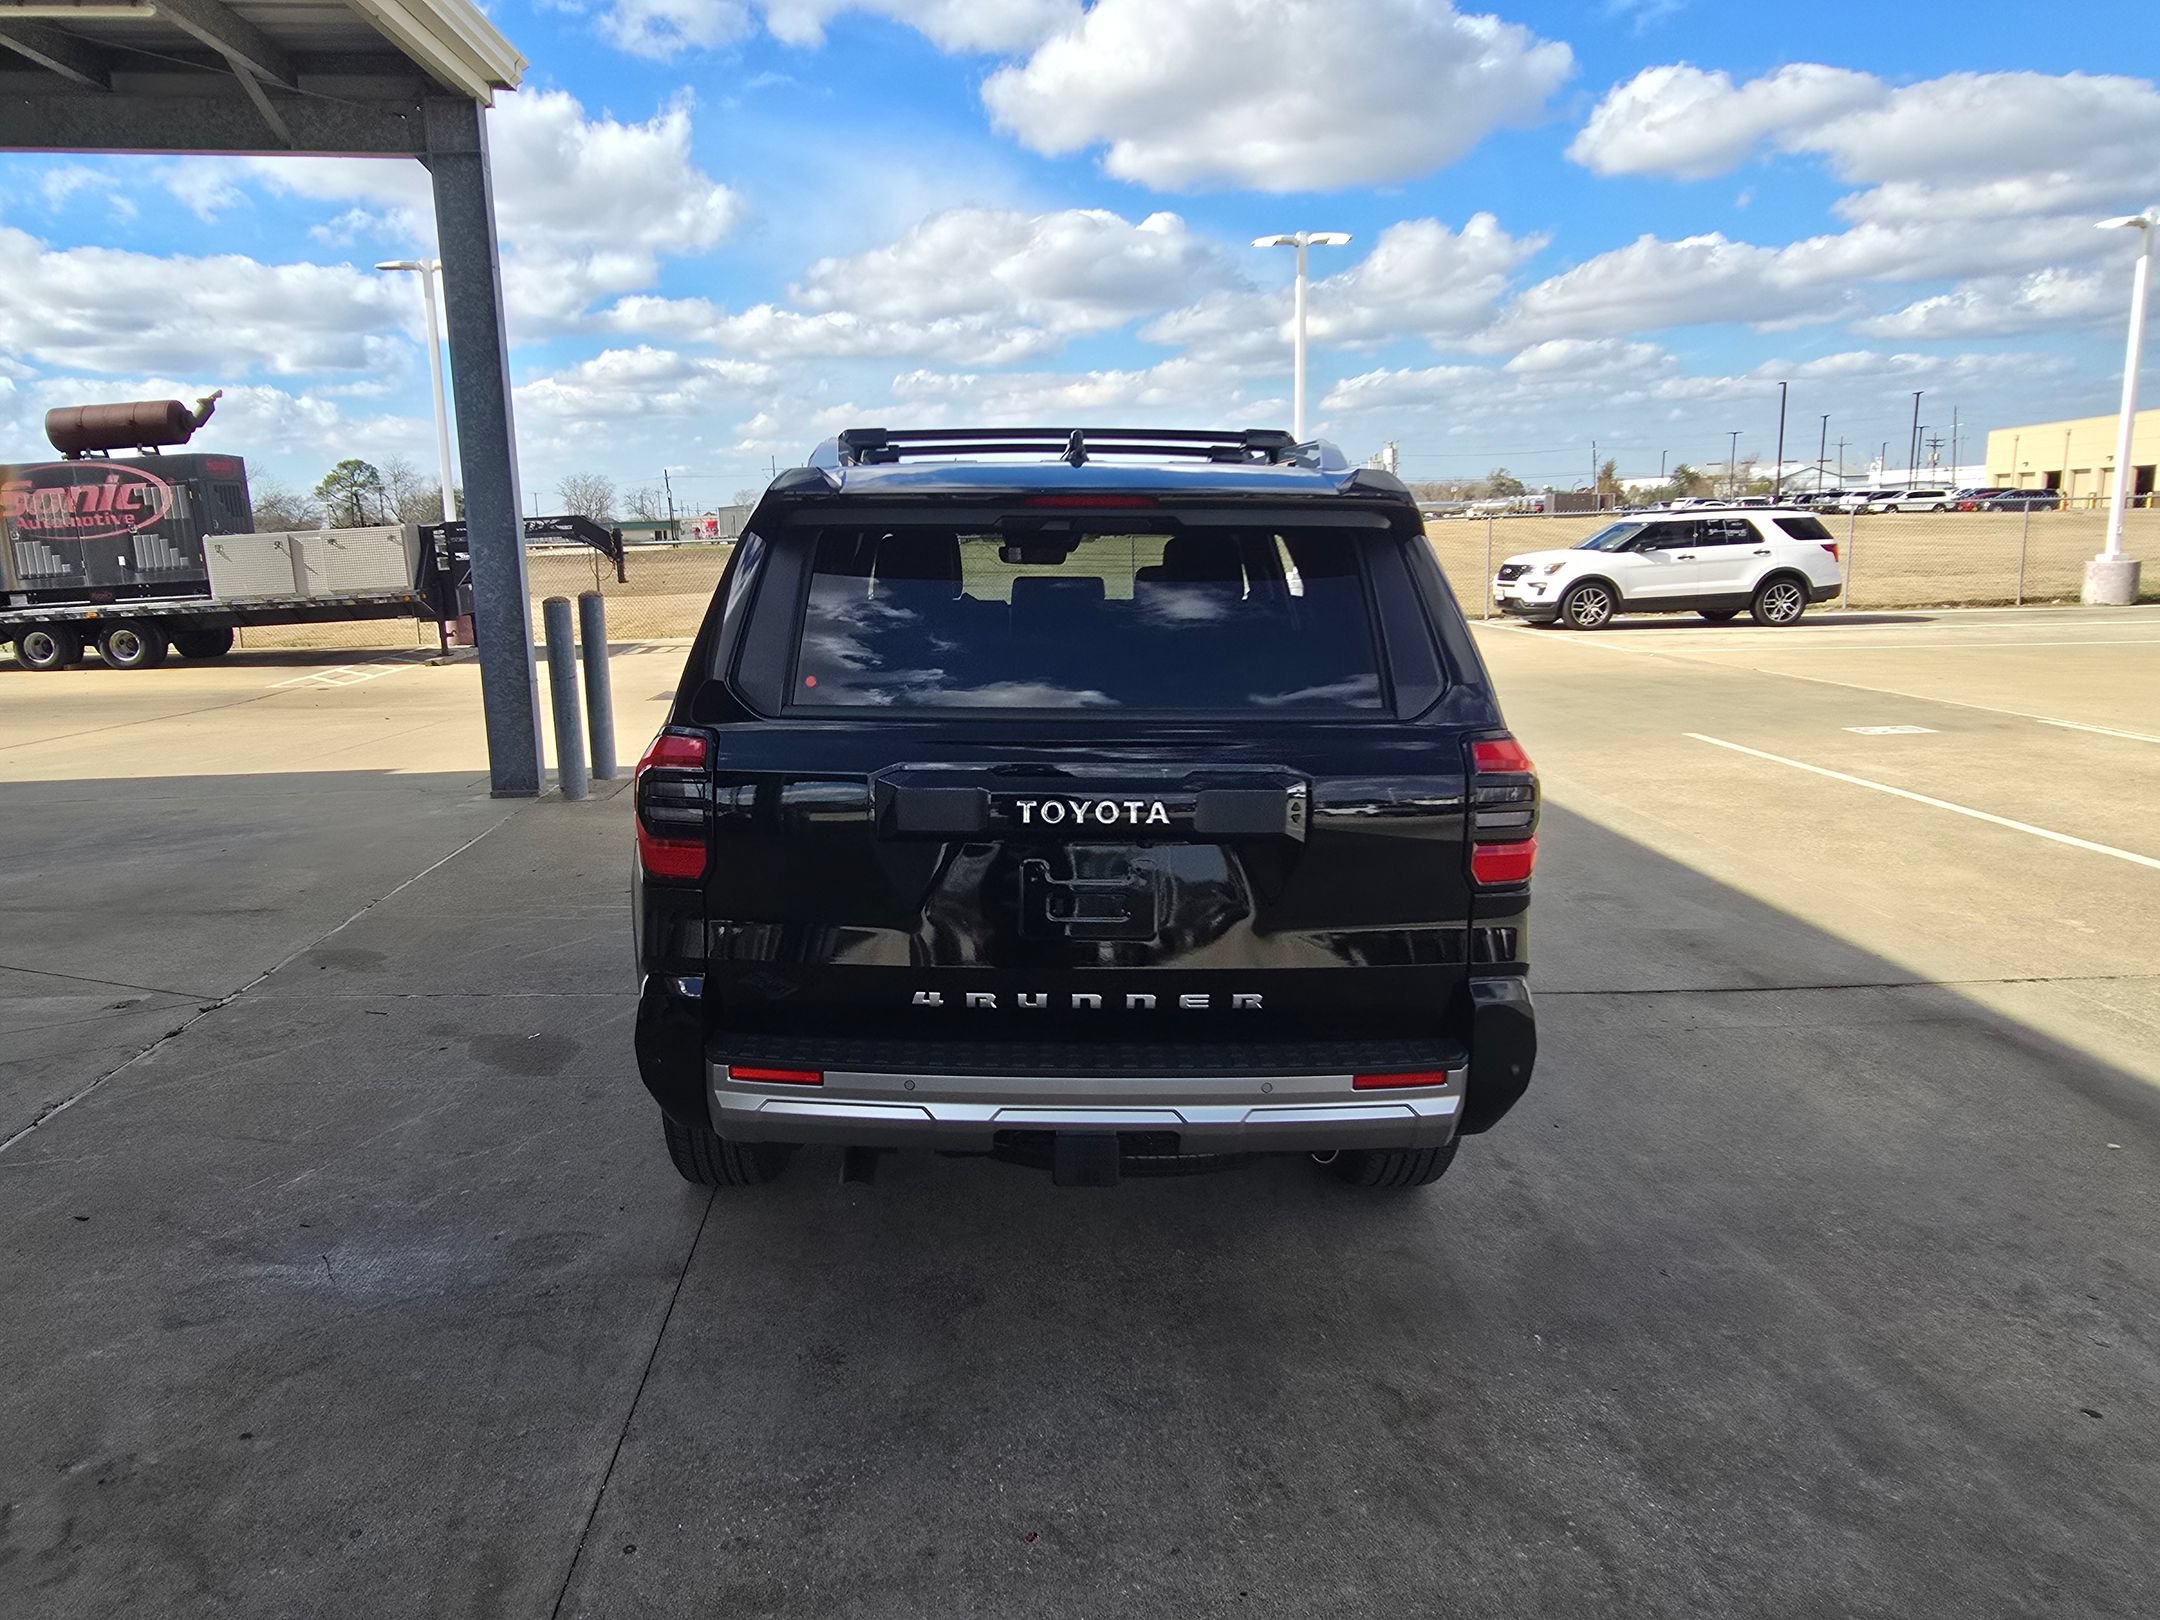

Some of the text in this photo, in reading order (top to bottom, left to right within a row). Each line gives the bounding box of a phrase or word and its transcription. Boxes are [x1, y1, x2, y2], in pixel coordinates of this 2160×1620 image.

[0, 474, 148, 517] Sonic
[16, 512, 136, 530] Automotive
[1016, 800, 1170, 824] TOYOTA
